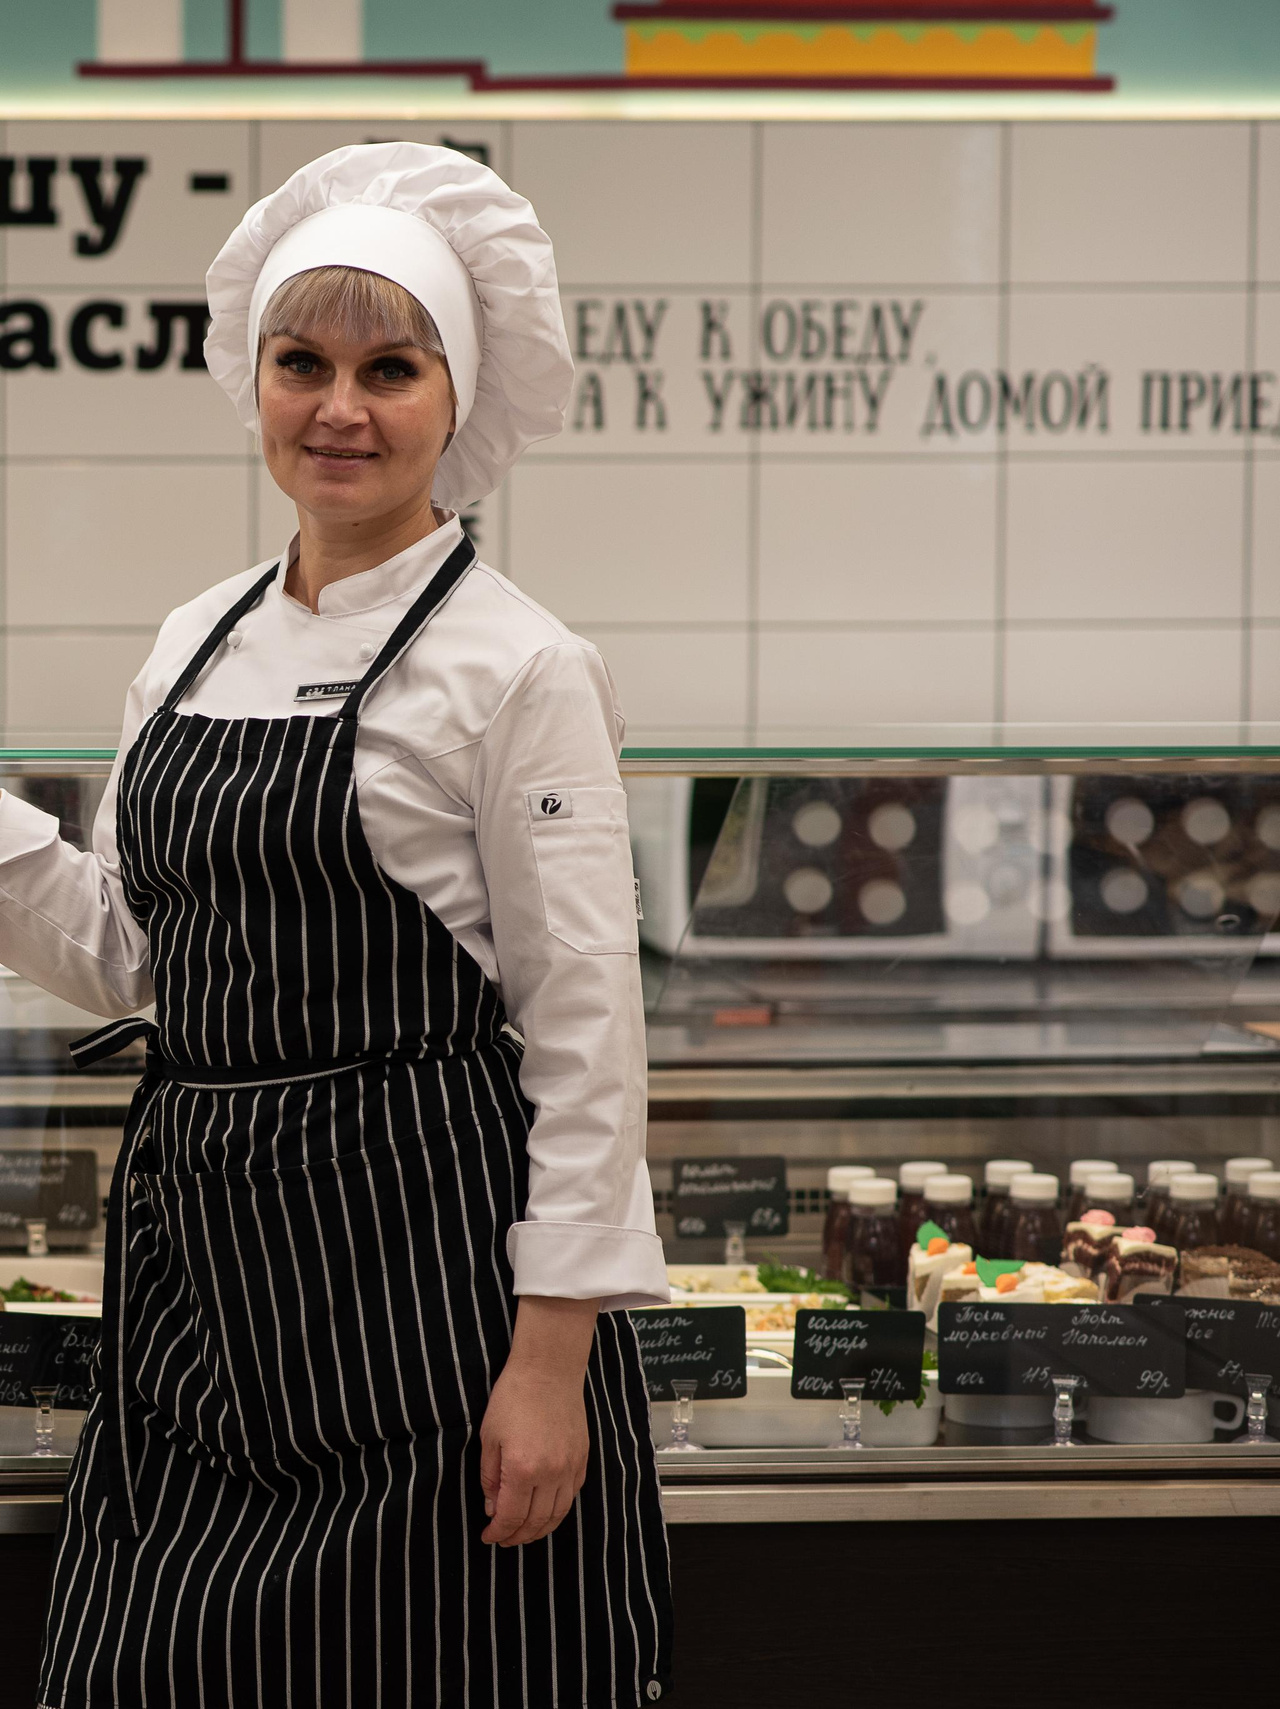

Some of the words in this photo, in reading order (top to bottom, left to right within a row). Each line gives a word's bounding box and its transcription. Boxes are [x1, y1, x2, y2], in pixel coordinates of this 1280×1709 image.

[188, 169, 234, 194] -
[697, 298, 732, 363] К
[571, 369, 606, 433] А
[634, 369, 668, 433] К
[698, 368, 894, 434] УЖИНУ
[920, 362, 1112, 441] ДОМОЙ
[1137, 368, 1280, 438] ПРИЕ
[943, 1326, 1048, 1348] морковный
